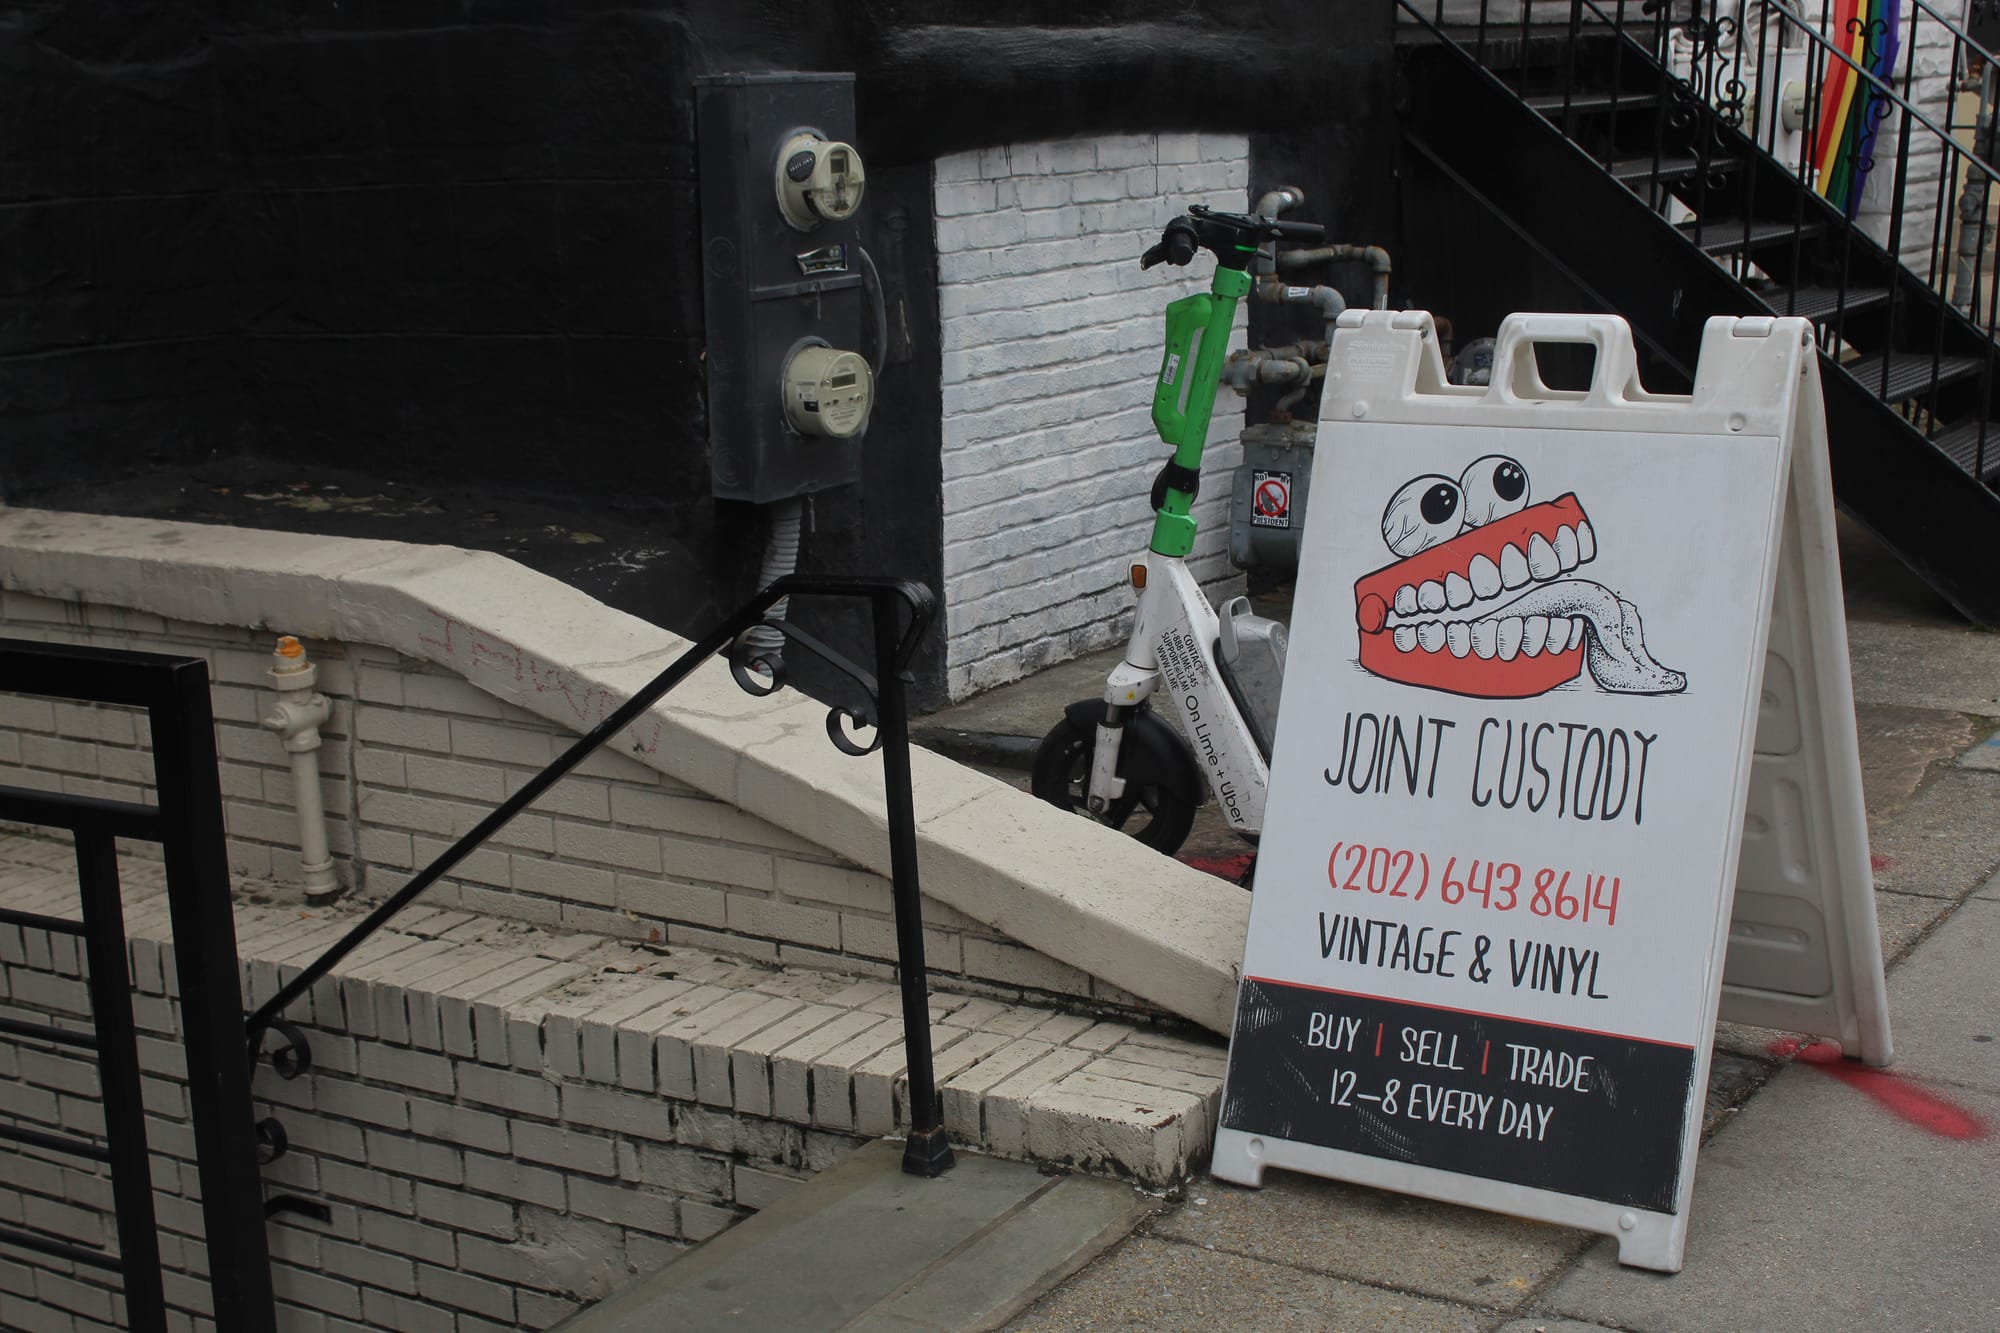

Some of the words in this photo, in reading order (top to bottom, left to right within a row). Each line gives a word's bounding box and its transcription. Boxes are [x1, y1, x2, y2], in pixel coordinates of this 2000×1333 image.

[1254, 472, 1269, 481] NOT
[1280, 473, 1291, 485] MY
[1253, 515, 1288, 527] PRESIDENT
[1156, 644, 1179, 691] WWW.LI.ME
[1170, 627, 1199, 688] 1-888-LIME-345
[1183, 634, 1203, 671] CONTACT
[1185, 694, 1200, 723] On
[1195, 724, 1218, 766] Lime
[1216, 770, 1224, 778] +
[1220, 781, 1245, 824] Uber
[1324, 712, 1456, 798] JOINT
[1471, 717, 1658, 826] CUSTODY
[1327, 841, 1430, 901] (202)
[1441, 857, 1522, 912] 643
[1529, 868, 1621, 926] 8614
[1319, 912, 1462, 978] VINTAGE
[1468, 935, 1492, 984] &
[1509, 938, 1609, 1000] VINYL
[1307, 1011, 1362, 1052] BUY
[1399, 1026, 1465, 1071] SELL
[1505, 1043, 1595, 1093] TRADE
[1407, 1083, 1494, 1131] EVERY
[1498, 1097, 1554, 1142] DAY
